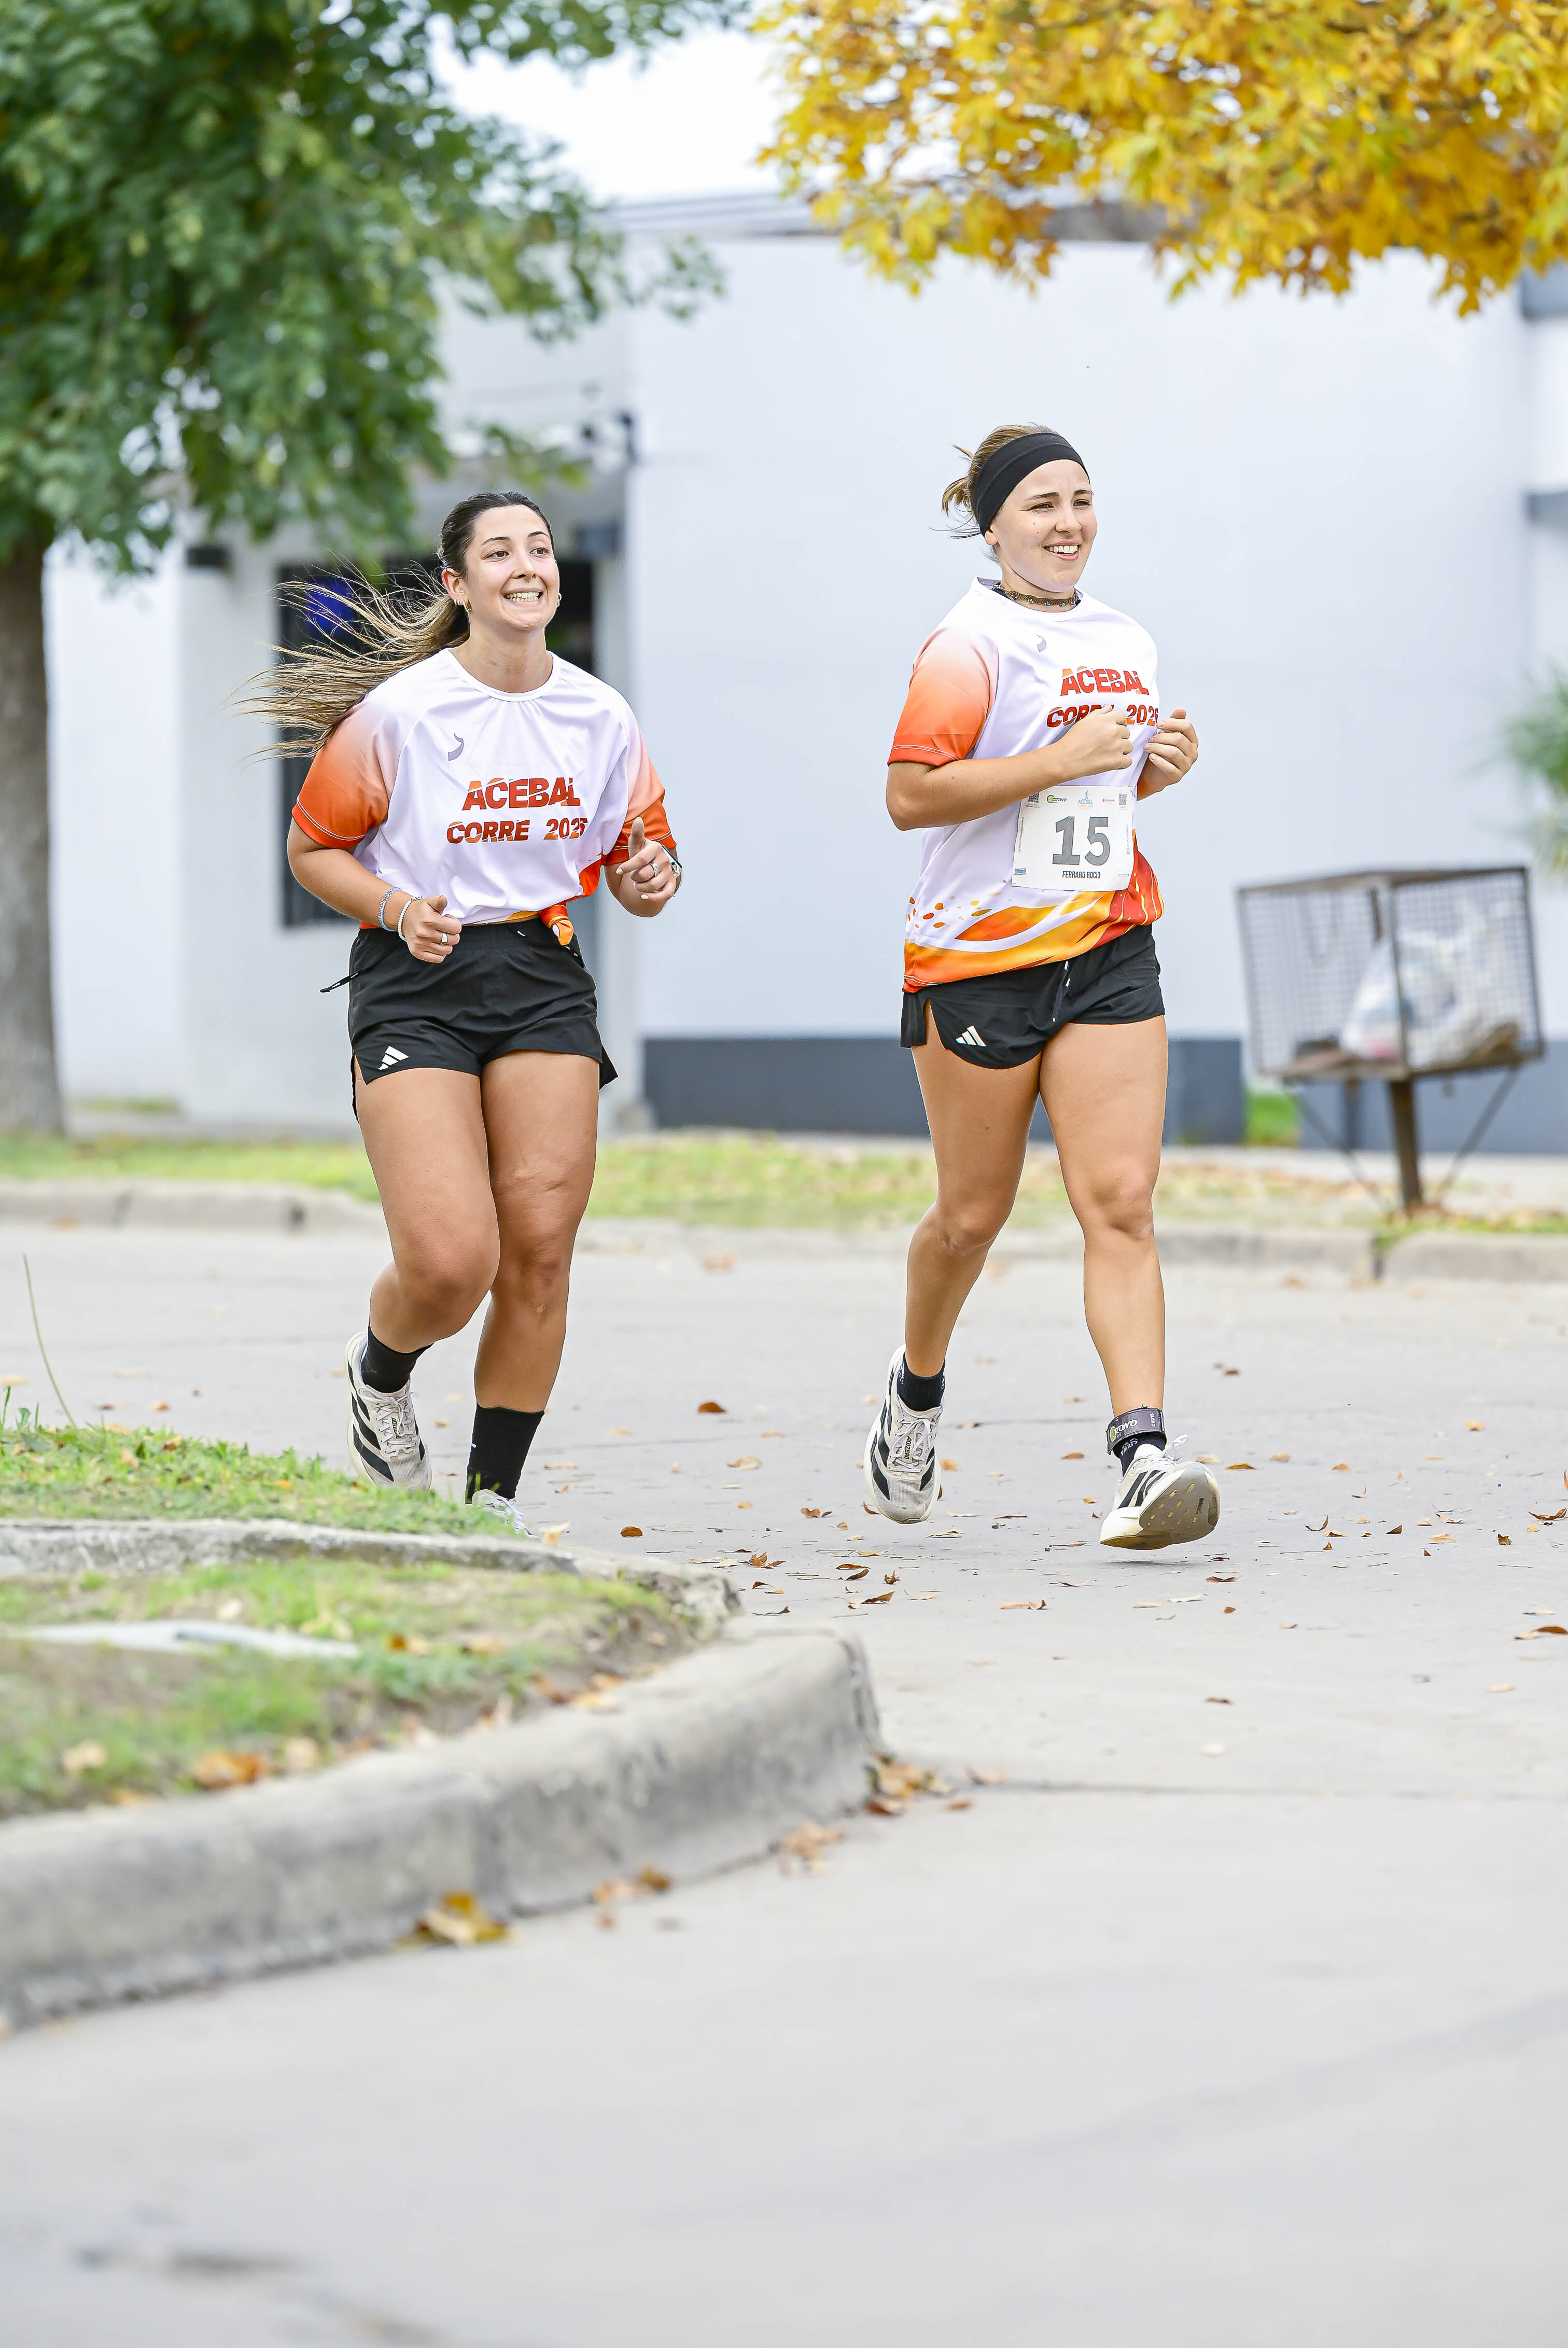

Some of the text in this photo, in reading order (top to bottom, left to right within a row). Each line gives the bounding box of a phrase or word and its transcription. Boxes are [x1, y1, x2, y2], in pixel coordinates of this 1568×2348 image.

[1060, 666, 1149, 696] ACEBAL
[1046, 705, 1114, 728] COR
[462, 777, 581, 810] ACEBAL
[447, 819, 530, 844] CORRE
[1053, 816, 1110, 865] 15
